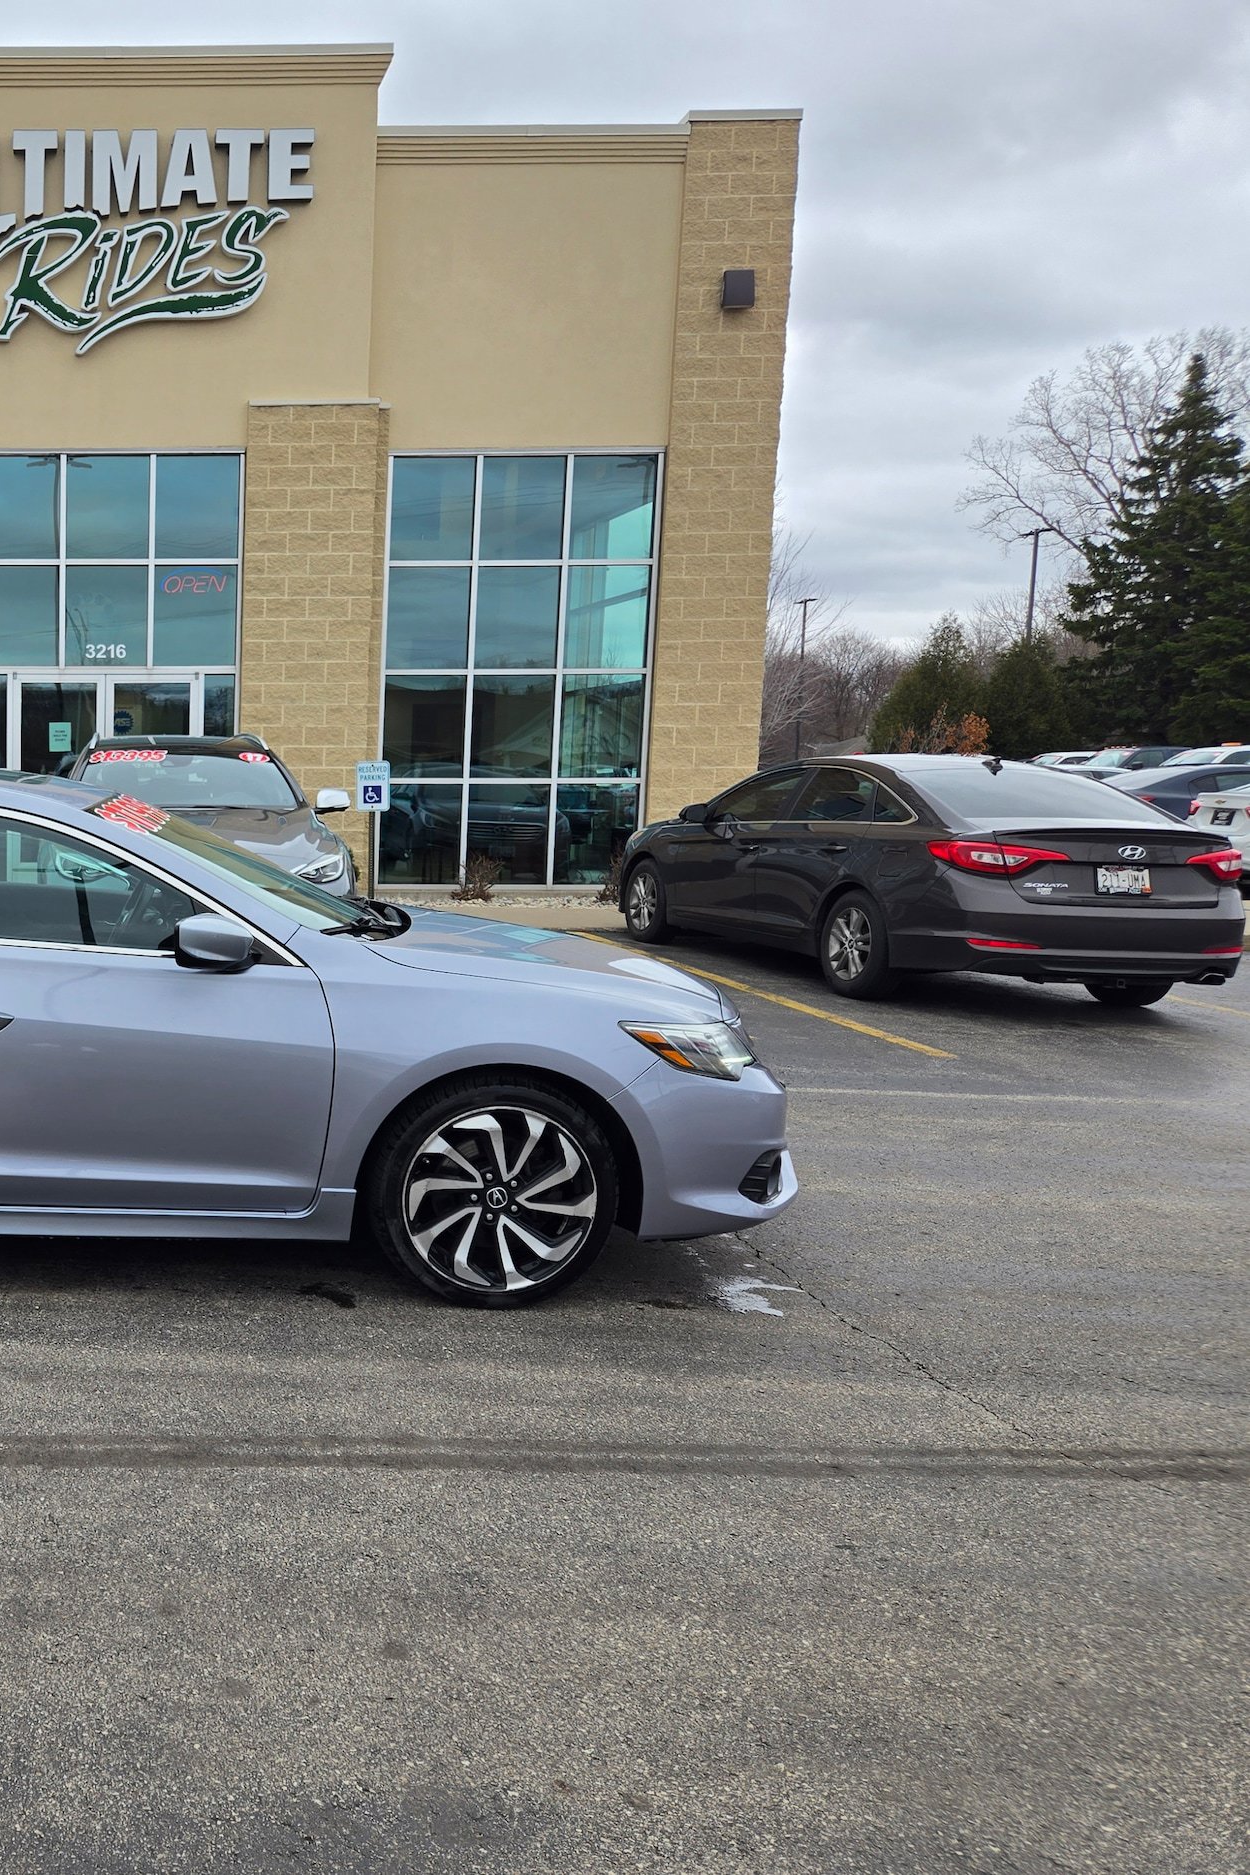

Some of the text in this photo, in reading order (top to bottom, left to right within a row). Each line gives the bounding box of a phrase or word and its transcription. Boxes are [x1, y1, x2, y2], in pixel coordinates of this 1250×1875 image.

[164, 575, 227, 593] OPEN
[85, 644, 127, 659] 3216
[89, 750, 168, 763] $13395
